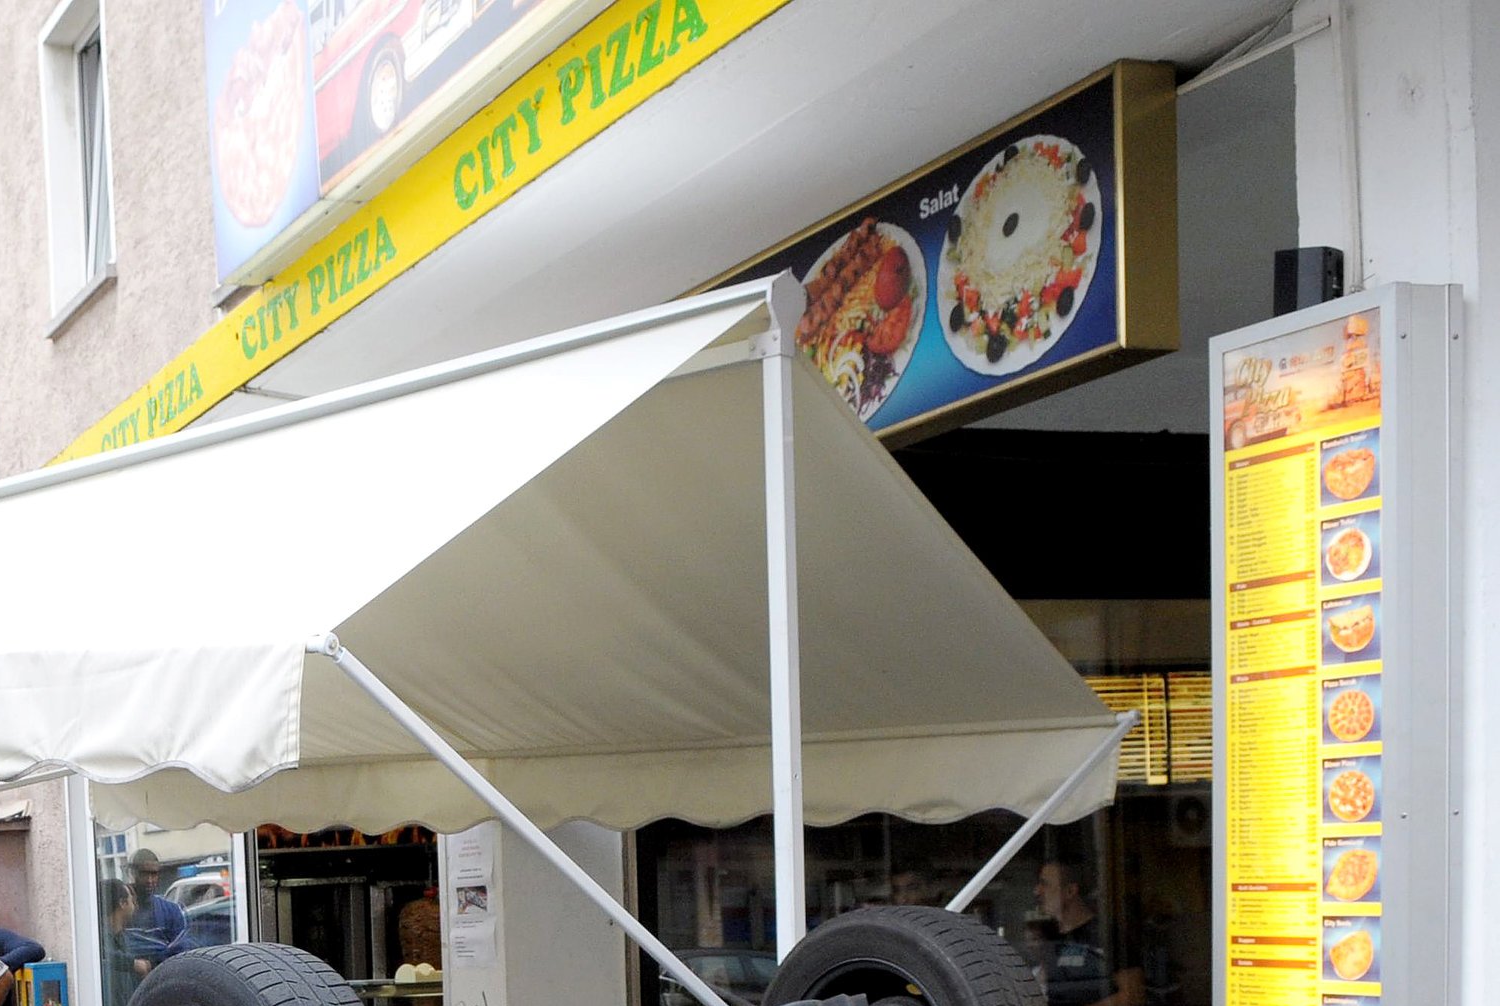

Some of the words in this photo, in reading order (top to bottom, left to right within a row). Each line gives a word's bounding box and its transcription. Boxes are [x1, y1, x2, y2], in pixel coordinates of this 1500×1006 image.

[452, 87, 546, 211] CITY
[558, 0, 709, 126] PIZZA
[919, 183, 960, 220] Salat
[241, 279, 300, 360] CITY
[307, 216, 397, 315] PIZZA
[101, 405, 141, 452] CITY
[147, 362, 204, 437] PIZZA
